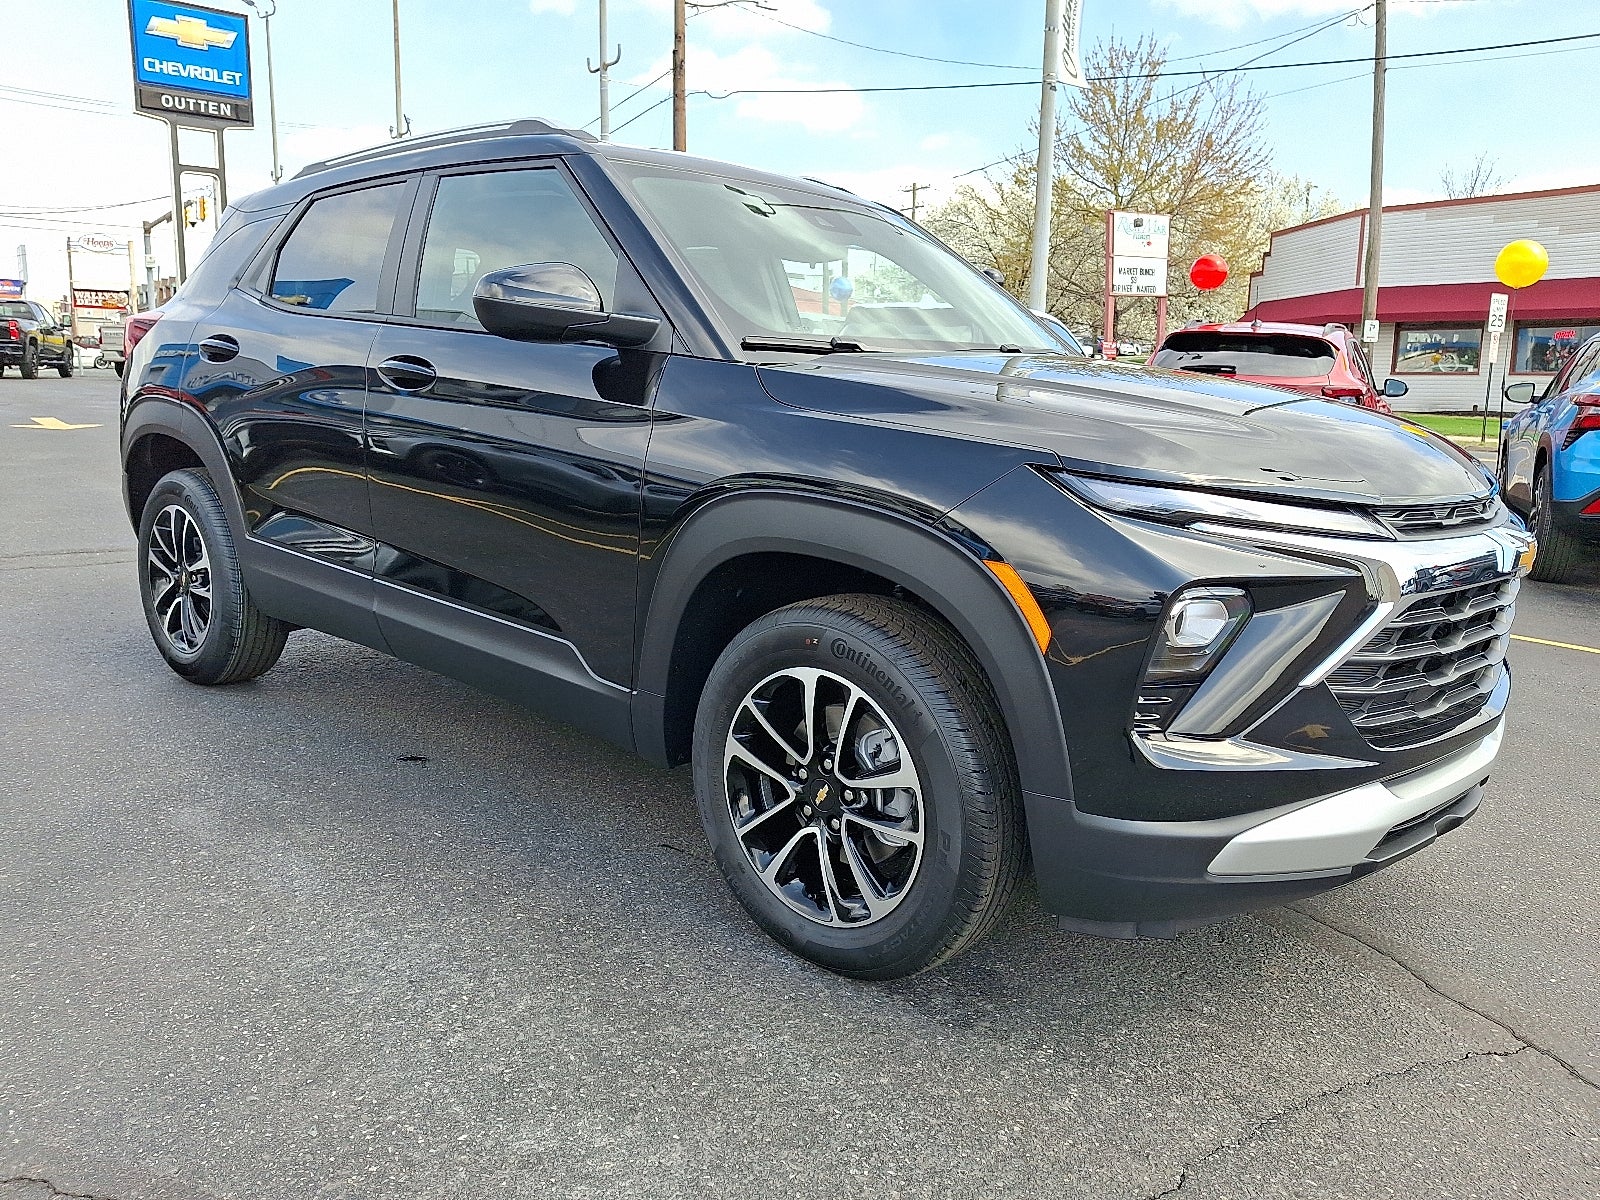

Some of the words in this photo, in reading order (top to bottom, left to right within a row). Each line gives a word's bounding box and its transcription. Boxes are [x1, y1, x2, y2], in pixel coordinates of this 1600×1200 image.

[143, 57, 243, 86] CHEVROLET
[161, 94, 232, 117] OUTTEN
[1118, 267, 1138, 276] MARKET
[1139, 268, 1155, 277] BUNCH
[1113, 284, 1133, 293] DRIVER
[1136, 285, 1157, 294] WANTED
[1490, 314, 1503, 328] 25
[830, 637, 916, 712] Continental
